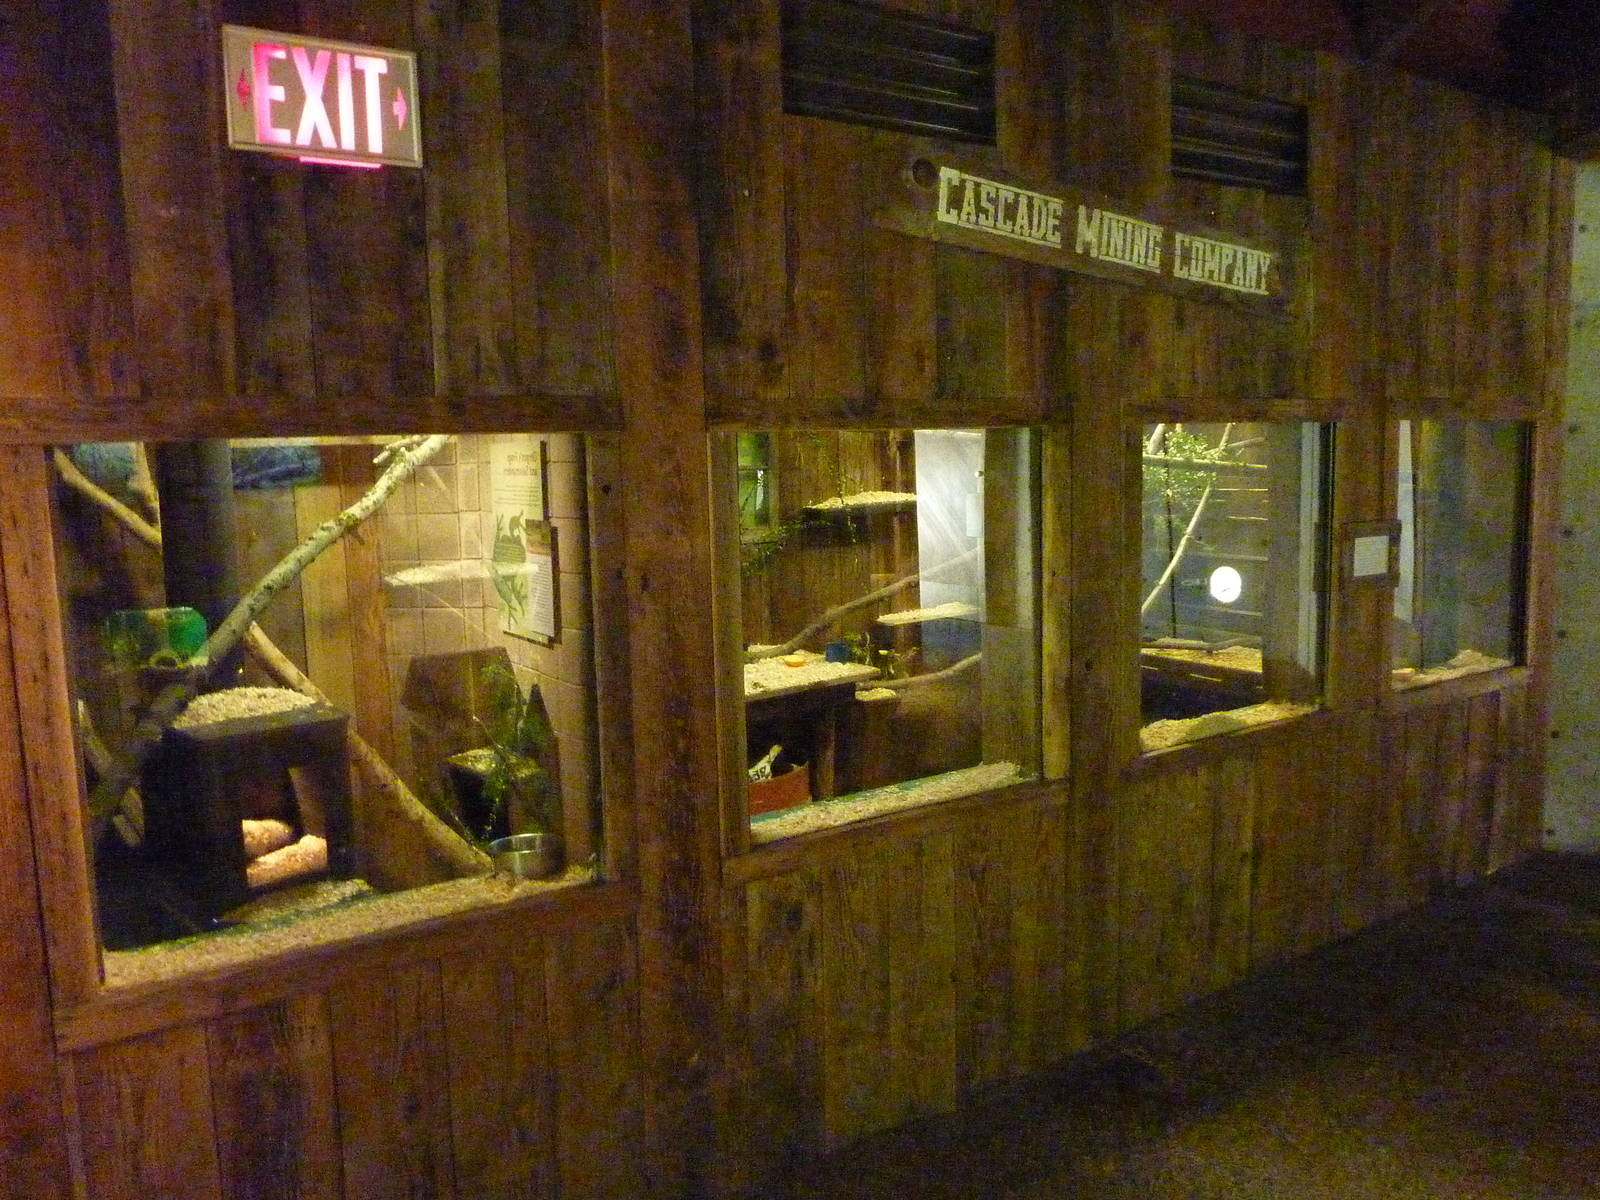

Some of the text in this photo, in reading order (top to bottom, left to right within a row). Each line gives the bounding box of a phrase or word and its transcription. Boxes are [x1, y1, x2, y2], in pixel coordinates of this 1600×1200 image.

[253, 42, 388, 154] EXIT
[937, 167, 1272, 294] CASCADE MINING COMPANY
